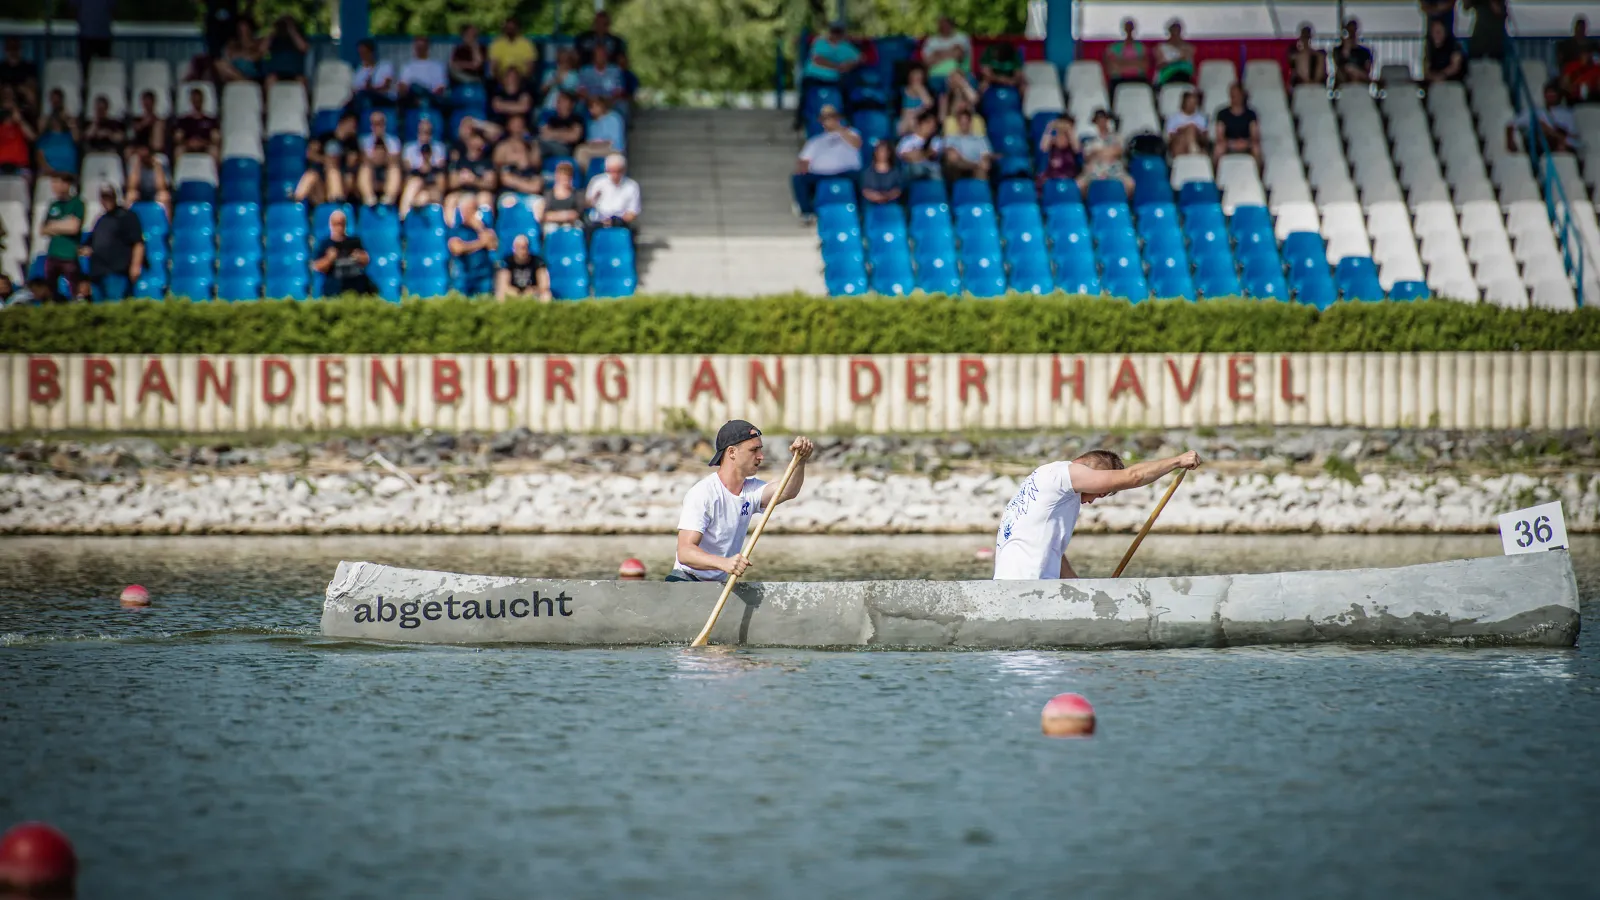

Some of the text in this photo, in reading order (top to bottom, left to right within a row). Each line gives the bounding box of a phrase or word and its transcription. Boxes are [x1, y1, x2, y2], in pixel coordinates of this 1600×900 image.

[28, 354, 1305, 405] BRANDENBURG AN DER HAVEL
[1514, 515, 1553, 548] 36
[353, 590, 574, 630] abgetaucht
